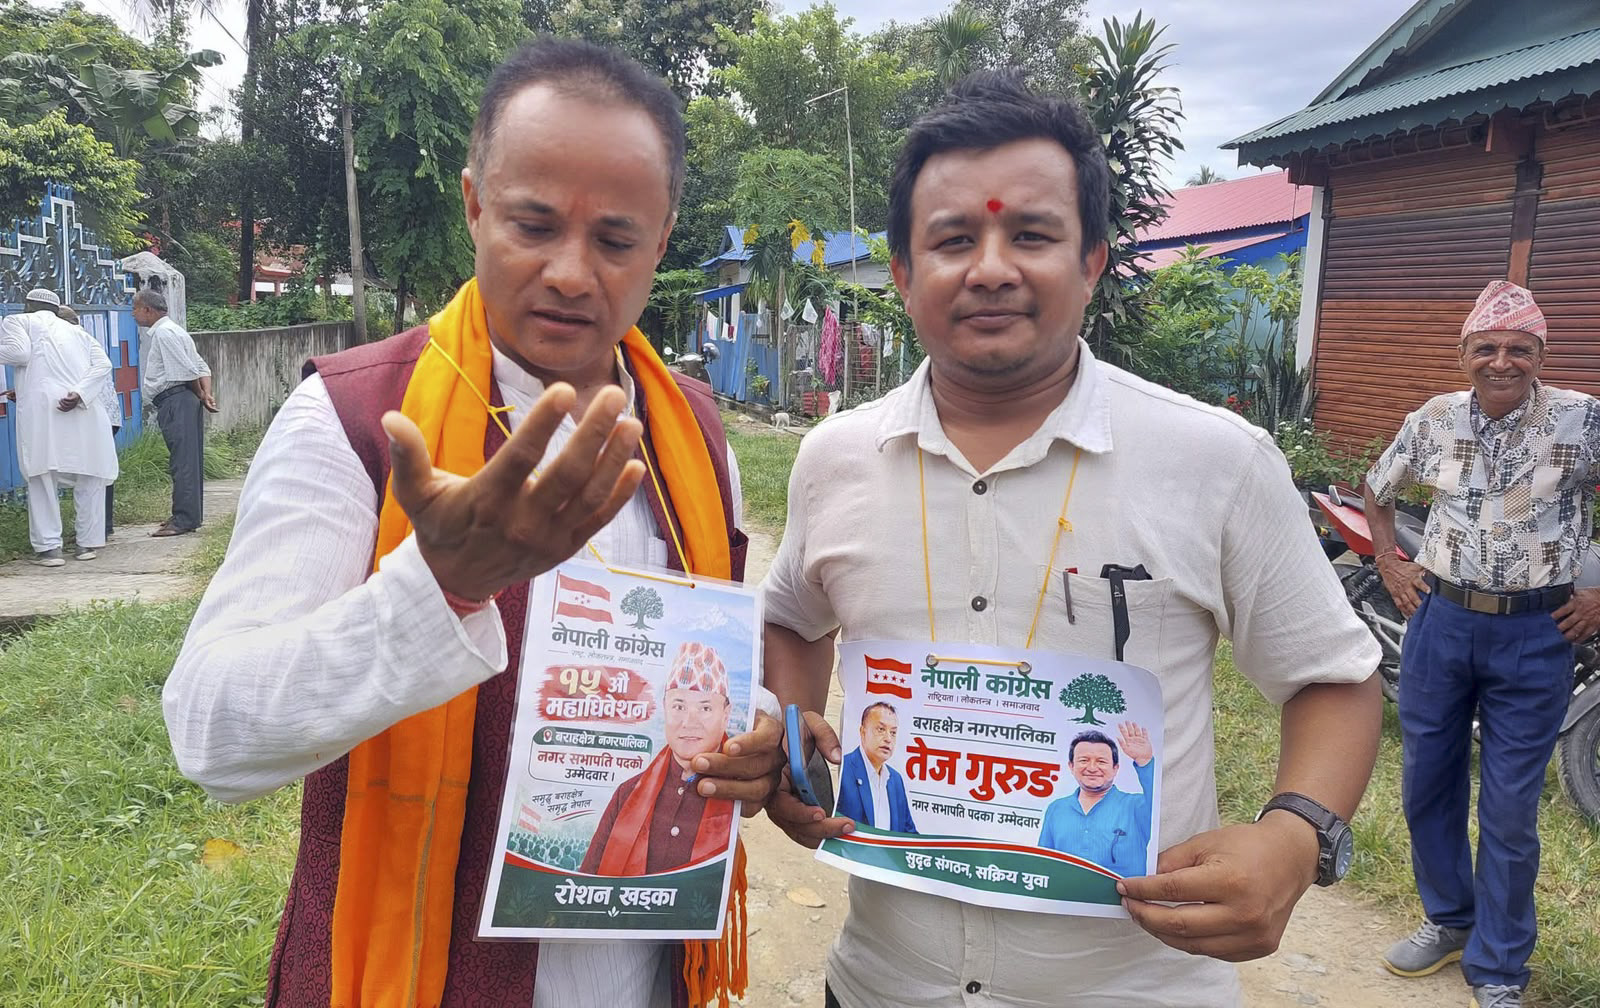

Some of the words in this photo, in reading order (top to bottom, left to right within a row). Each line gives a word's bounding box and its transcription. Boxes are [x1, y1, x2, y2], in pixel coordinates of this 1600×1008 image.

[552, 622, 610, 650] नेपाली
[614, 633, 666, 658] कांग्रेस
[560, 668, 601, 695] १५
[607, 671, 630, 693] औ
[545, 694, 650, 719] महाधिवेशन
[960, 695, 991, 706] लोकतन्त्र
[1002, 700, 1040, 712] समाजवाद
[555, 731, 595, 745] बराहक्षेत्र
[598, 735, 649, 749] नगरपालिका
[913, 716, 964, 734] बराहक्षेत्र
[967, 722, 1056, 745] नगरपालिका
[537, 751, 566, 764] नगर
[569, 752, 613, 767] सभापति
[616, 756, 644, 769] पदको
[565, 766, 609, 781] उम्मेदवार
[905, 737, 961, 785] तेज
[965, 753, 1060, 801] गुरुङ
[571, 799, 592, 809] नेपाल
[911, 799, 929, 812] नगर
[931, 802, 965, 818] सभापति
[967, 809, 994, 822] पदका
[997, 811, 1041, 829] उम्मेदवार
[905, 851, 932, 870] सुदृढ
[934, 855, 972, 879] संगठन,
[975, 864, 1018, 883] सक्रिय
[1022, 872, 1049, 890] युवा
[554, 878, 614, 905] रोशन
[619, 886, 678, 910] खड्का
